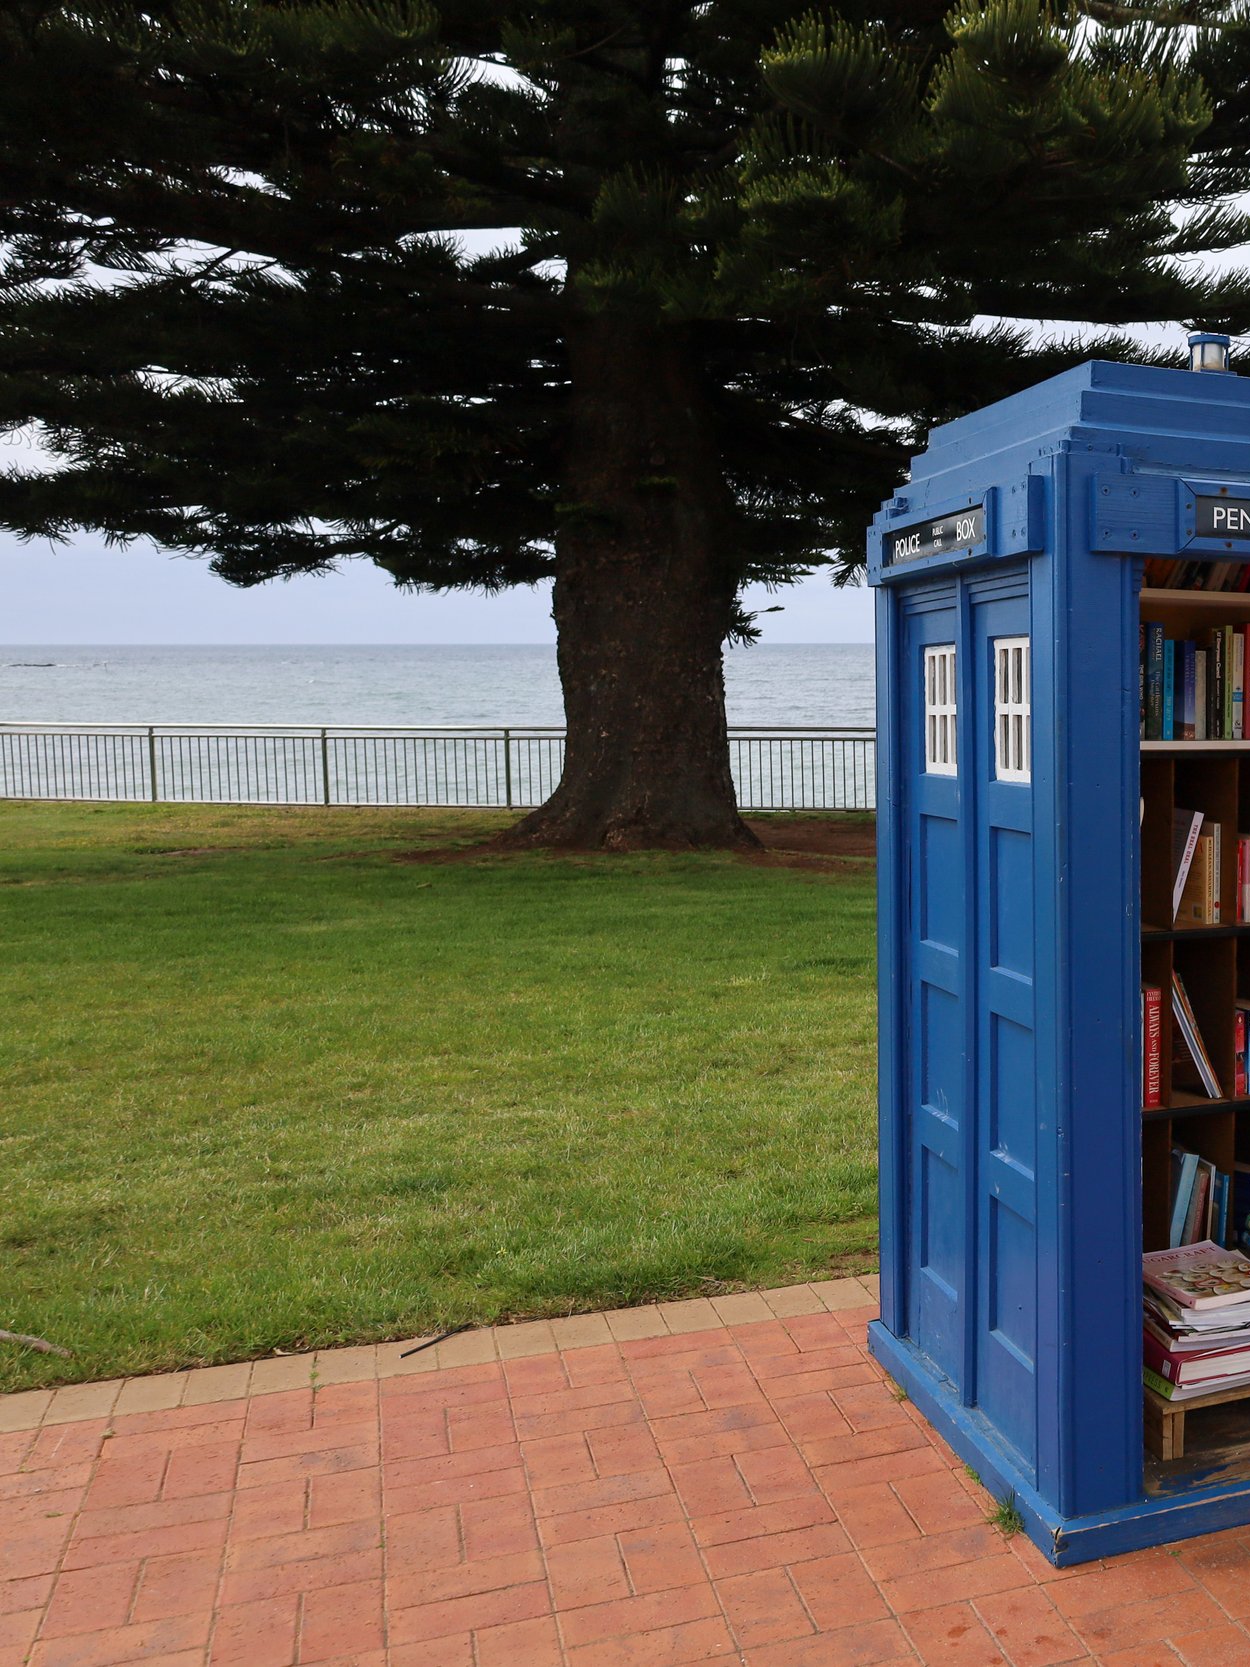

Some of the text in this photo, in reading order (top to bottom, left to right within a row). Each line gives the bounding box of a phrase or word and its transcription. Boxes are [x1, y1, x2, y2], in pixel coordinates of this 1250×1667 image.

[895, 517, 976, 559] POLICE BOX
[932, 525, 944, 537] PUBLIC
[933, 538, 943, 548] CALL
[1148, 1005, 1160, 1038] ALWAYS
[1148, 1052, 1160, 1094] FOREVER
[1142, 1246, 1217, 1264] UGARCRAFT
